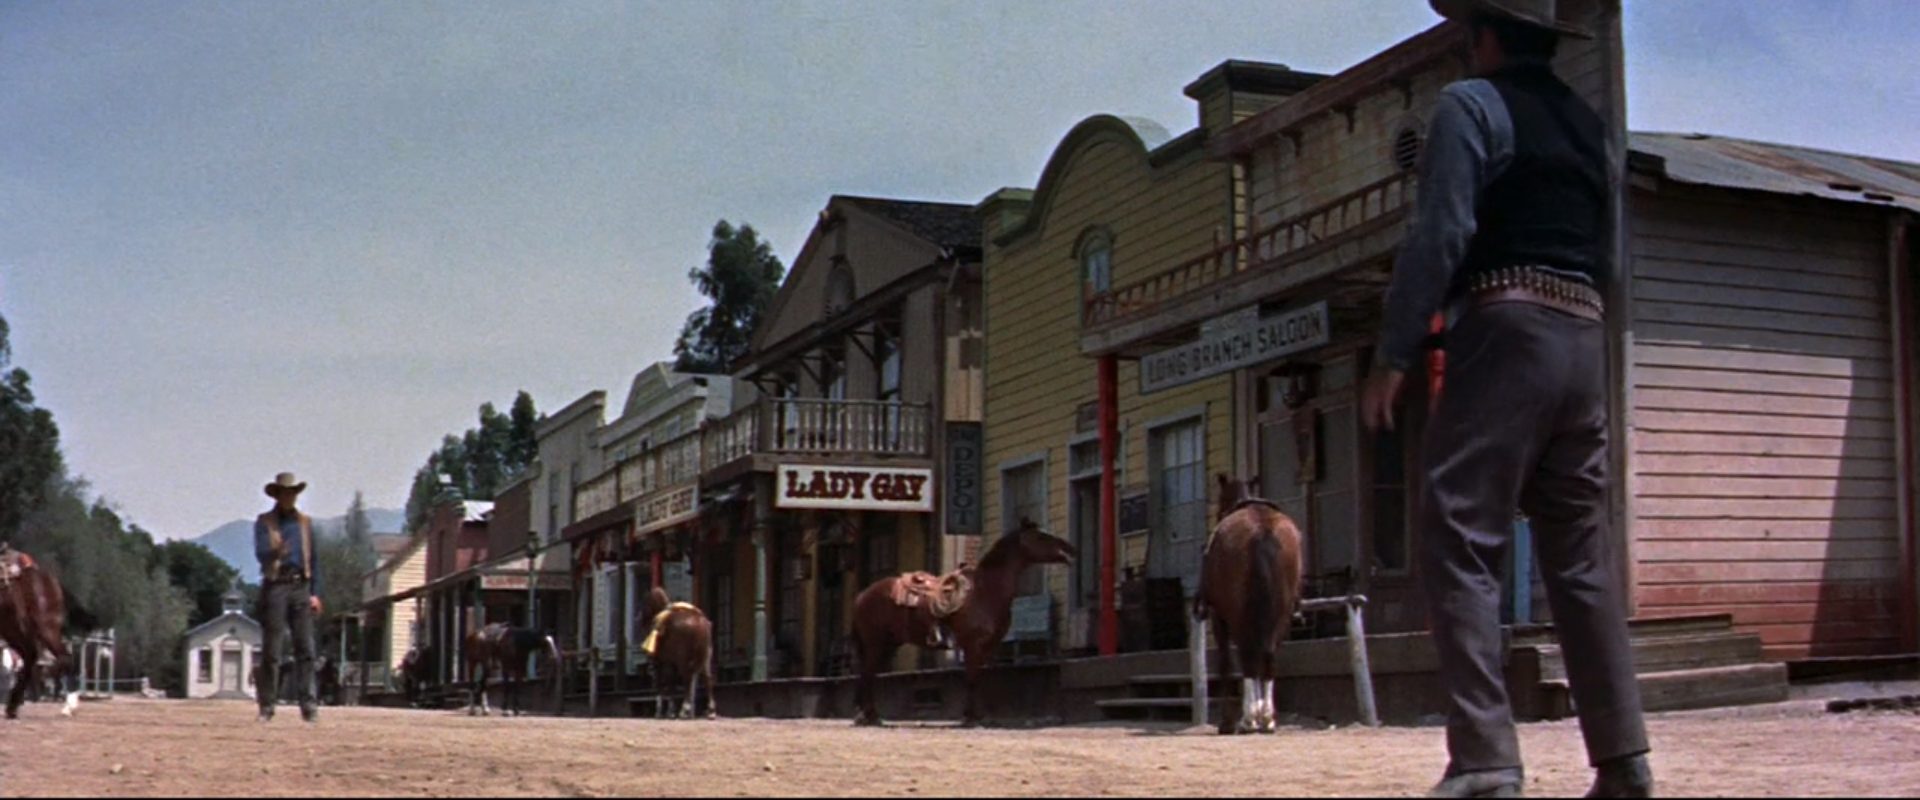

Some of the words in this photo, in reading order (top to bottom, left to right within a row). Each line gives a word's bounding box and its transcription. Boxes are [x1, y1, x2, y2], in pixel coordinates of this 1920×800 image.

[1148, 352, 1187, 383] LONG
[1192, 332, 1252, 372] BRANCH
[1257, 310, 1322, 352] SALOON
[785, 470, 870, 499] LADY
[871, 473, 927, 502] GAY
[953, 446, 976, 526] DEPOT
